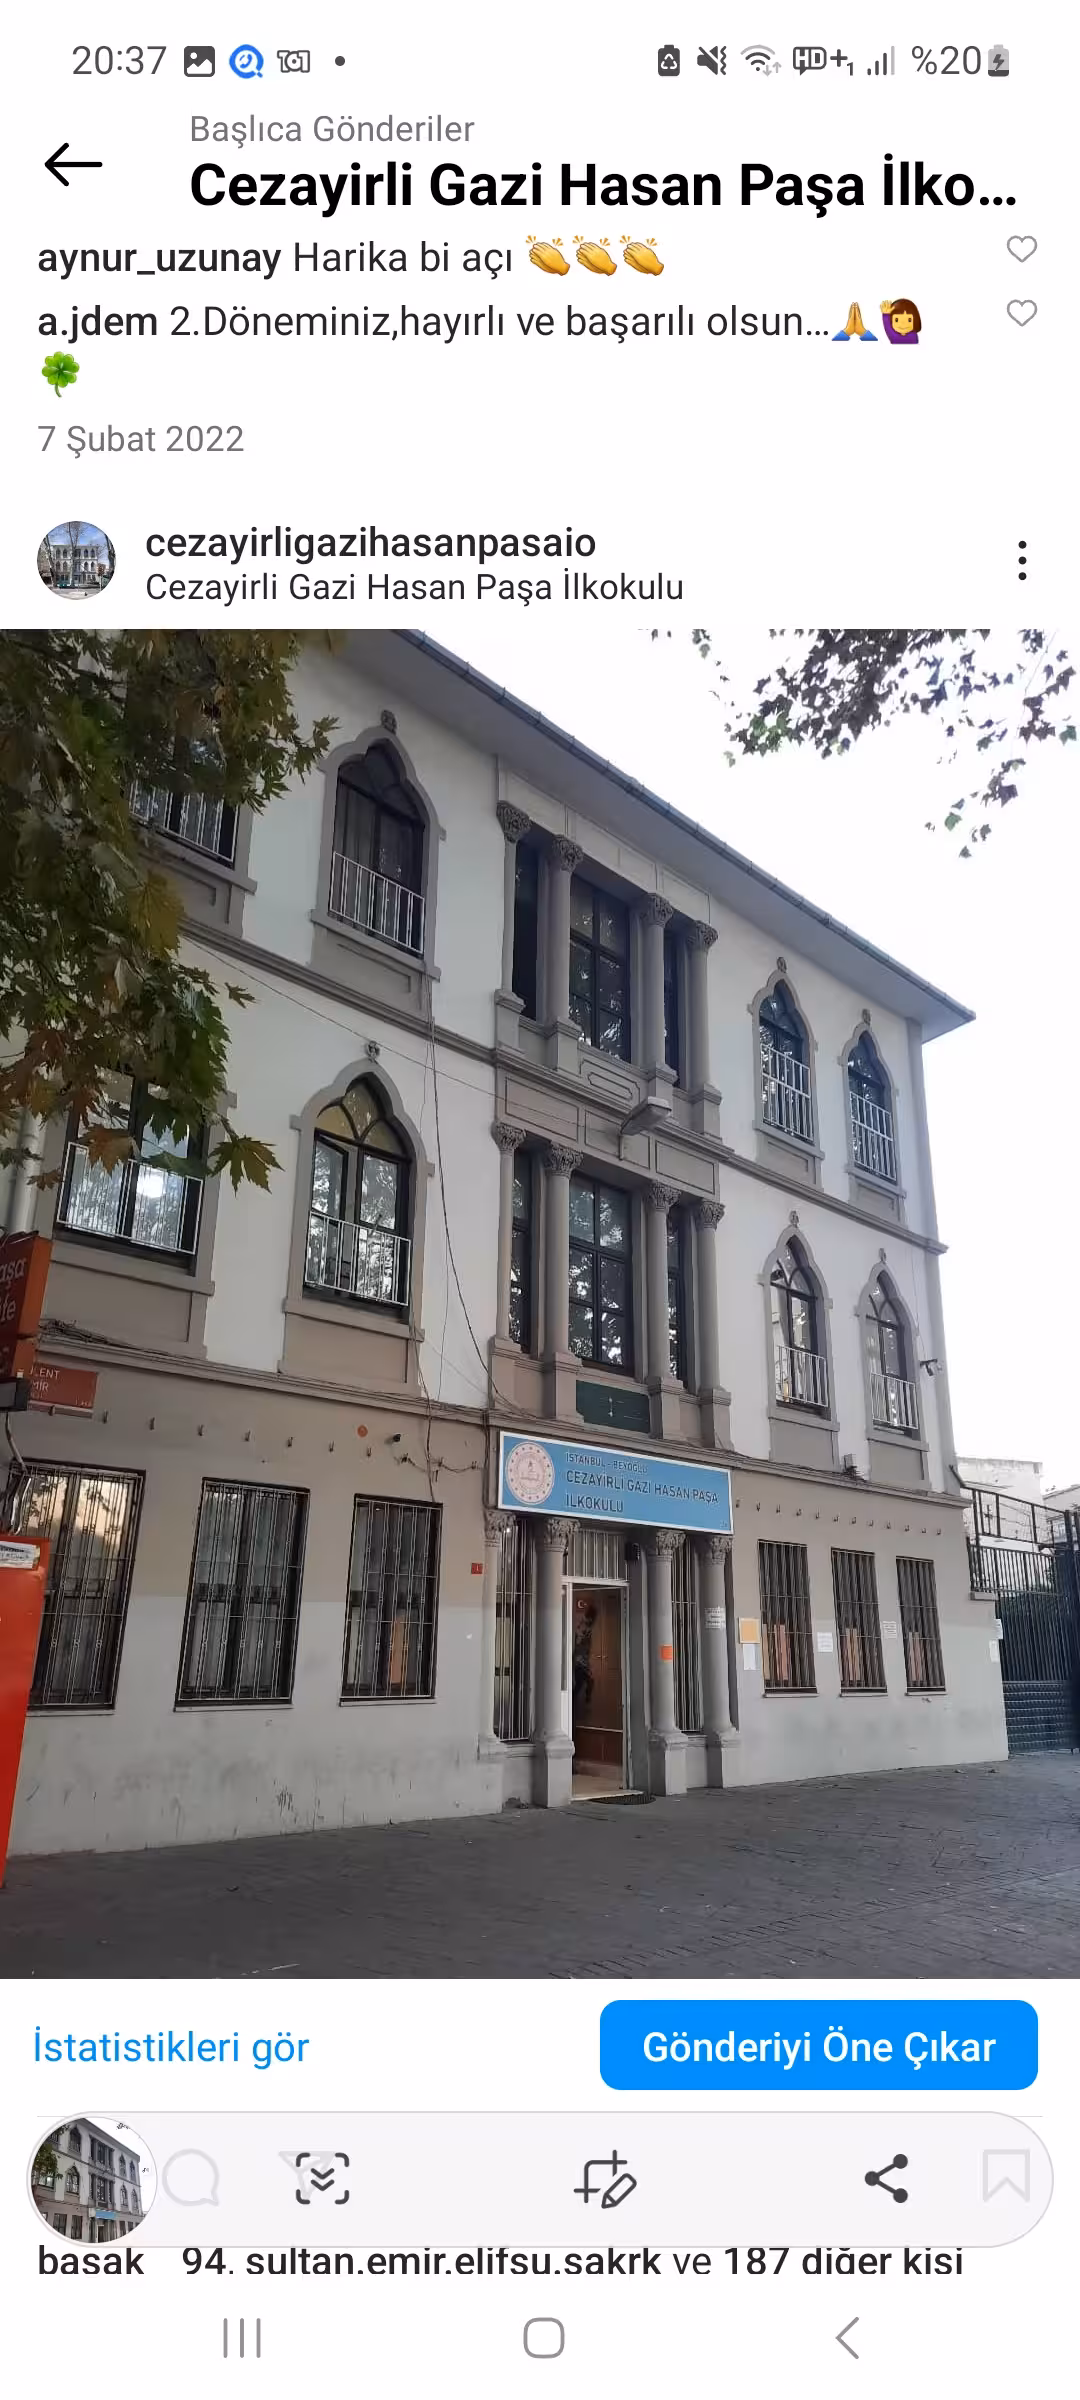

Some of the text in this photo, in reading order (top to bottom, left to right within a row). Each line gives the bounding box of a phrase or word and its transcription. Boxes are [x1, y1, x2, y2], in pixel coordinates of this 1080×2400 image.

[73, 46, 166, 74] 20:37
[912, 46, 981, 74] %20
[190, 114, 475, 148] Başlıca Gönderiler
[190, 161, 412, 218] Cezayirli
[430, 162, 541, 207] Gazi
[560, 164, 722, 207] Hasan
[740, 164, 865, 218] Paşa
[38, 241, 512, 281] aynur_uzunay Harika bi açı
[38, 305, 158, 344] a.jdem
[170, 305, 504, 344] 2.Döneminiz,hayırlı
[517, 313, 555, 337] ve
[567, 305, 694, 344] başarılı
[38, 425, 244, 458] 7 Şubat 2022
[146, 526, 596, 569] cezayirligazihasanpasaio
[146, 569, 683, 607] Cezayirli Gazi Hasan Paşa İlkokulu
[566, 1491, 624, 1513] İLKOKULU
[654, 1484, 690, 1500] HASAN
[692, 1488, 719, 1506] PAŞA
[34, 2026, 311, 2070] İstatistikleri gör
[643, 2026, 997, 2070] Gönderiyi Öne Çıkar
[672, 2253, 712, 2275] ve
[724, 2248, 790, 2275] 187
